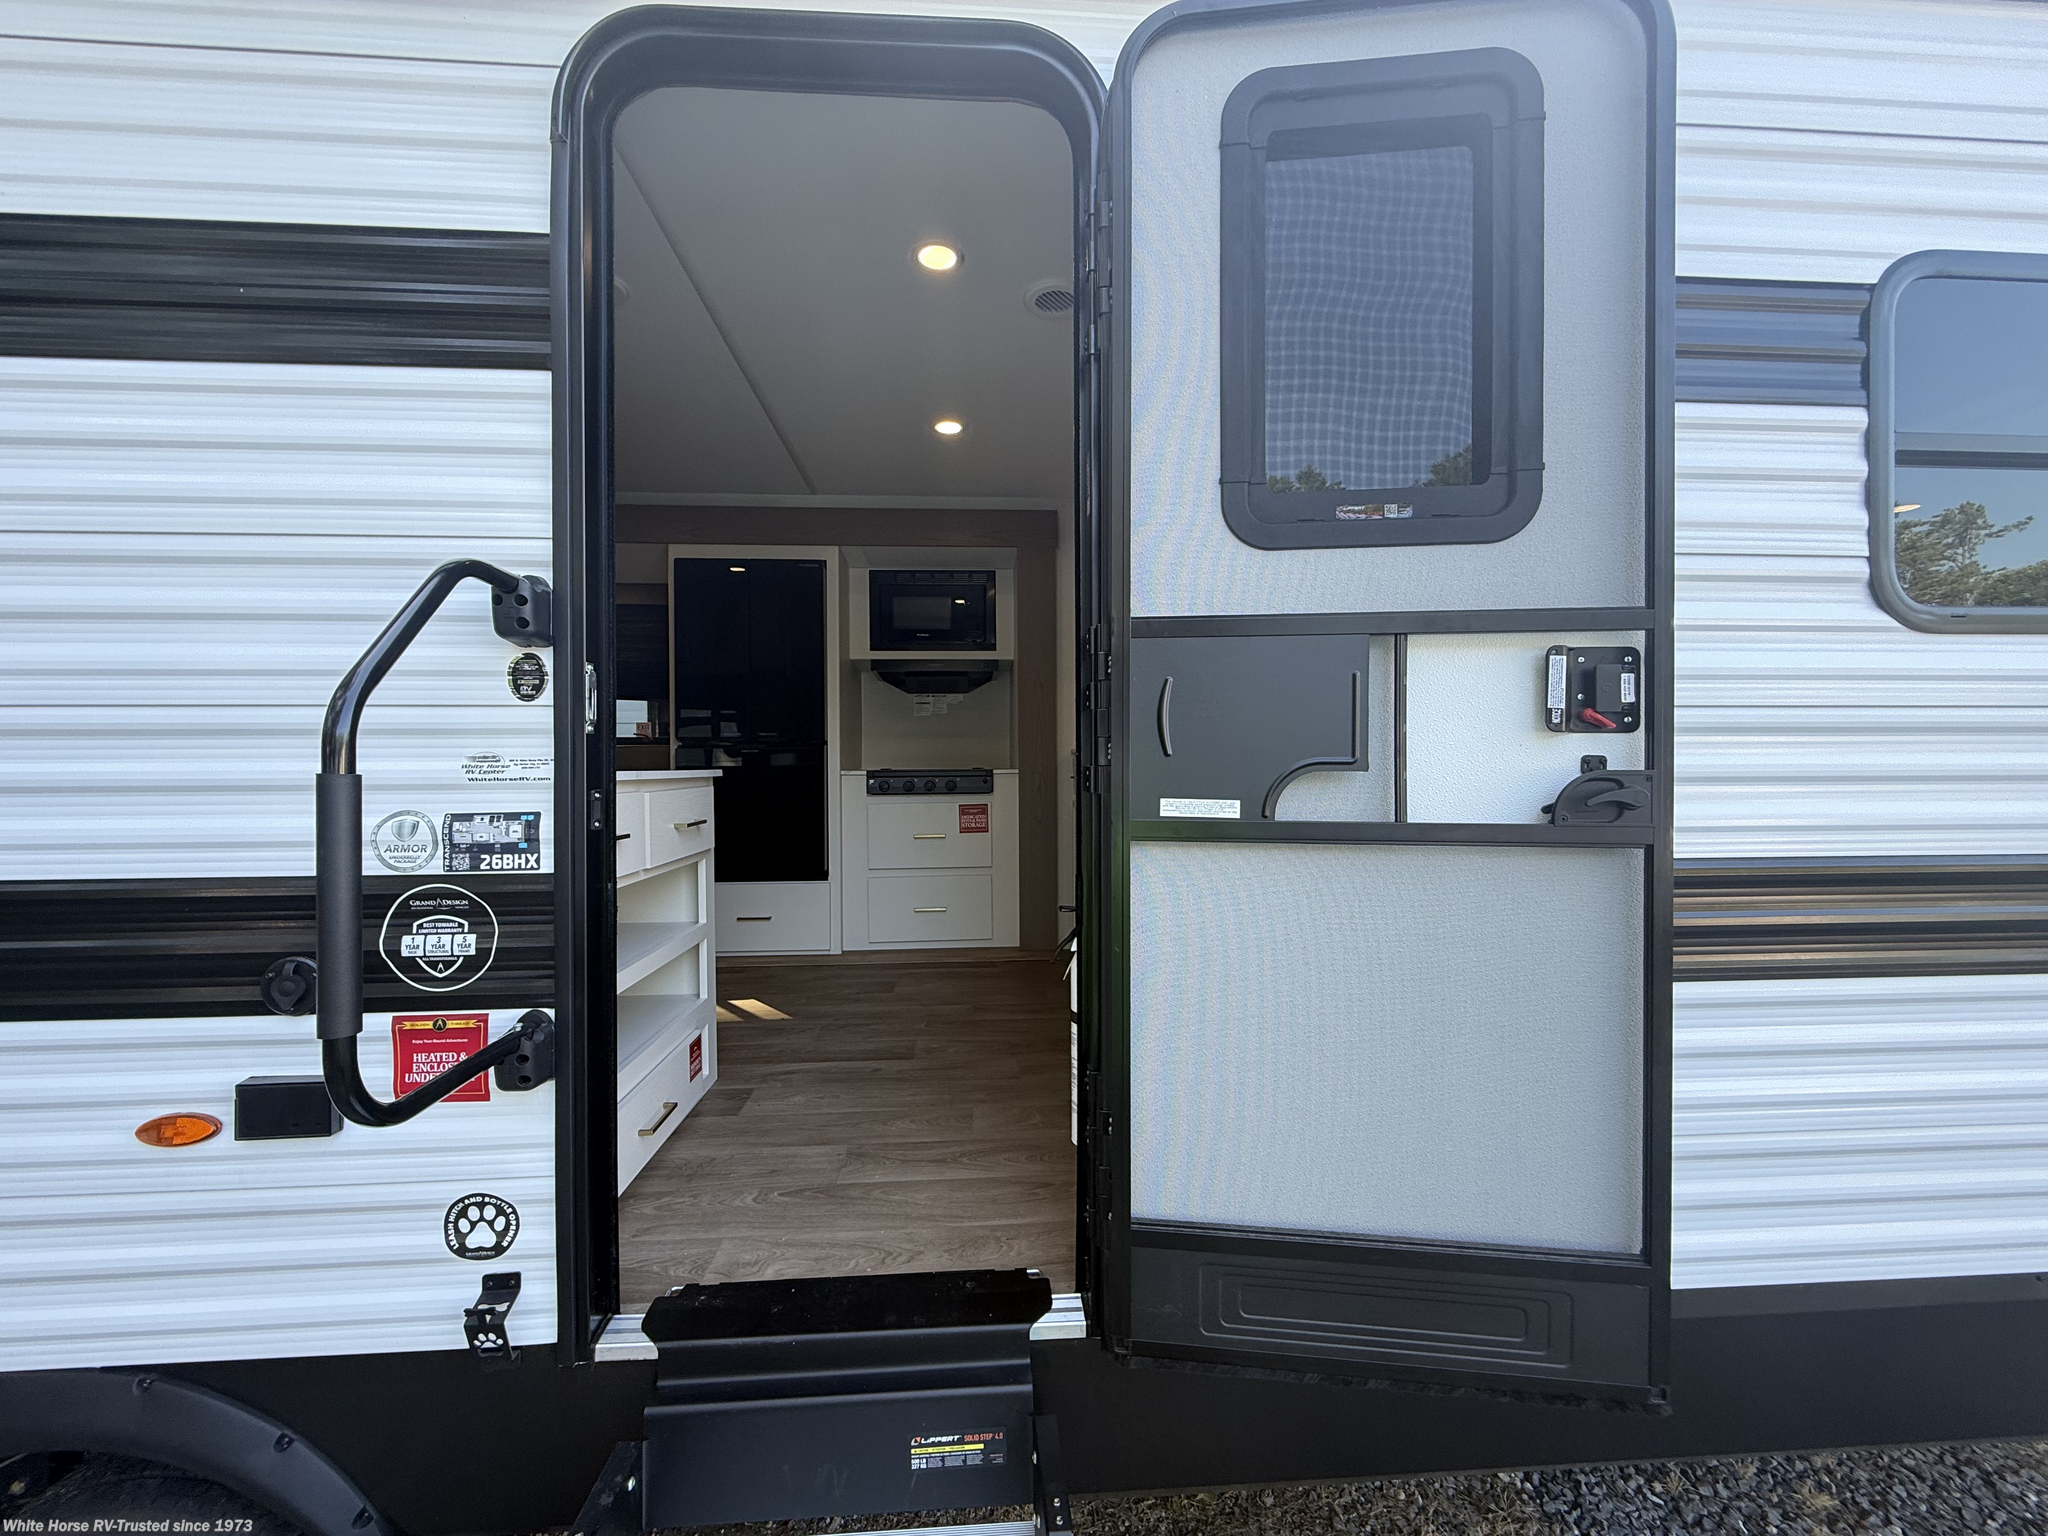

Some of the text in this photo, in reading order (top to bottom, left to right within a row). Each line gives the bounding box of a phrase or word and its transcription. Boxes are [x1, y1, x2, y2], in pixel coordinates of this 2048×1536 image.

[444, 814, 452, 872] TRANSCEND
[384, 844, 428, 853] ARMOR
[480, 853, 538, 870] 26BHX
[412, 1052, 468, 1062] HEATED &
[412, 1062, 459, 1072] ENCLOS
[448, 1197, 516, 1250] LEASH HITCH AND BOTTLE OPENER
[964, 1434, 980, 1442] SOLID
